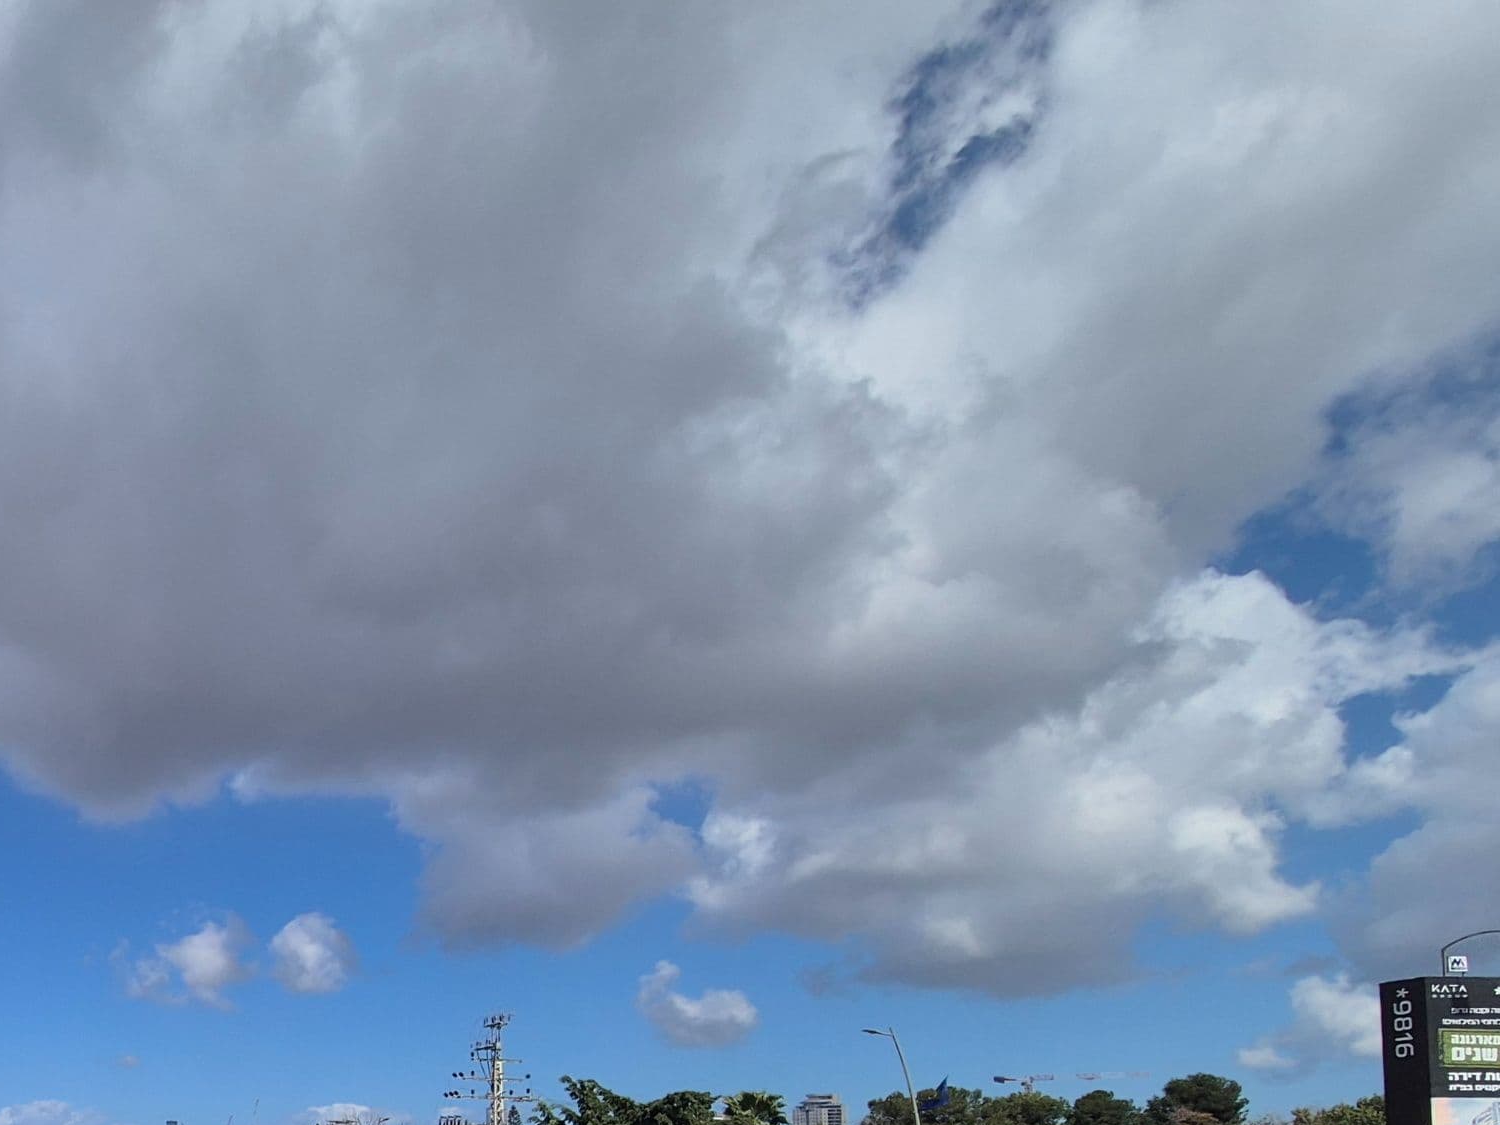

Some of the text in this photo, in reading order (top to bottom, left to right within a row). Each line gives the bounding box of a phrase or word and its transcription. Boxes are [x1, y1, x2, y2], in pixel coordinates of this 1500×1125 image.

[1431, 984, 1467, 993] KATA
[1451, 1046, 1498, 1062] שנים
[1448, 1072, 1482, 1081] דירה
